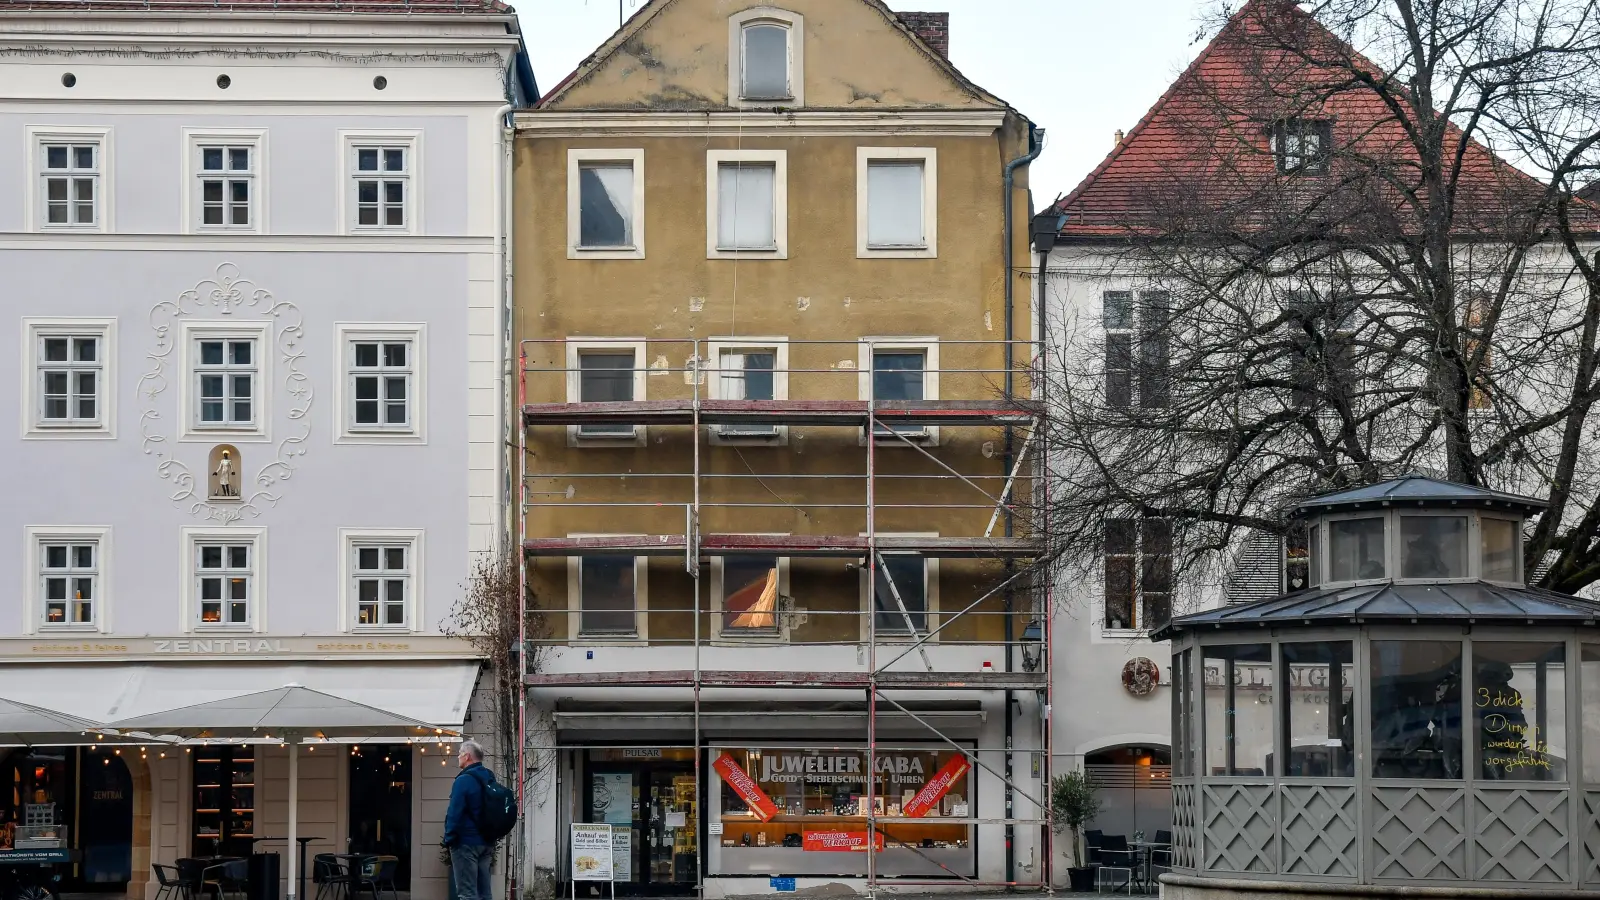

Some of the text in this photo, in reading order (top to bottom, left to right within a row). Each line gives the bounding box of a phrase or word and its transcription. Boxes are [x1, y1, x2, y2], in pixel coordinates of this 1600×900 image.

[83, 643, 91, 651] &
[153, 640, 291, 653] ZENTRAL
[366, 642, 374, 650] &
[1475, 687, 1490, 707] 3
[1487, 738, 1523, 749] wurden
[625, 749, 660, 757] PULSAR
[760, 755, 861, 783] JUWELIER
[891, 774, 925, 784] UHREN
[728, 773, 761, 802] VERKAUF
[922, 771, 951, 805] VERKAUF
[93, 790, 123, 799] ZENTRAL
[823, 838, 862, 847] VERKAUF
